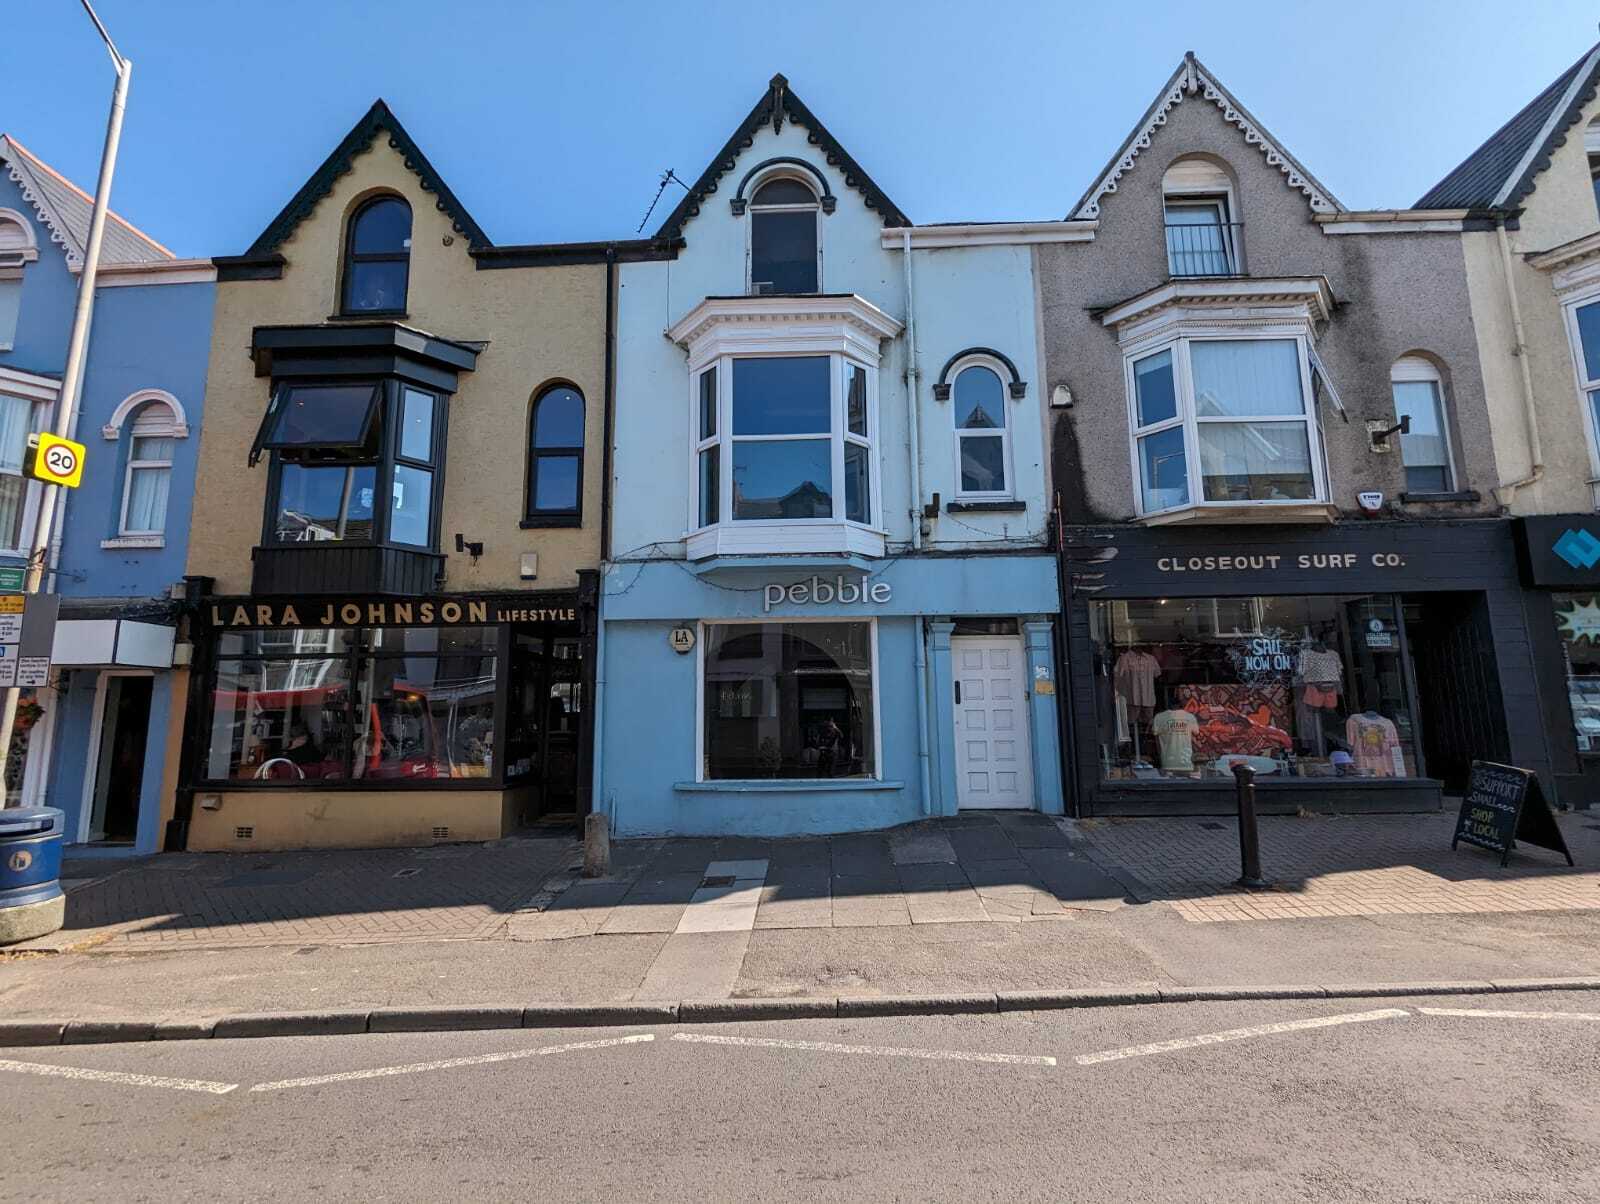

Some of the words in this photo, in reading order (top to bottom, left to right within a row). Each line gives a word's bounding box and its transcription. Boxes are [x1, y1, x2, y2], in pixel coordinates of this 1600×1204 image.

[50, 451, 73, 470] 20
[1157, 555, 1281, 571] CLOSEOUT
[1298, 553, 1358, 569] SURF
[1371, 553, 1407, 567] CO.
[763, 574, 892, 612] pebble
[211, 604, 301, 626] LARA
[320, 601, 487, 625] JOHNSON
[498, 608, 576, 622] LIFESTYLE
[675, 631, 689, 642] LA
[1245, 655, 1270, 671] NOW
[1273, 655, 1291, 671] ON
[1479, 775, 1521, 800] SUPPORT
[1471, 790, 1497, 807] SMALL
[1471, 807, 1495, 823] SHOP
[1472, 823, 1500, 841] LOCAL
